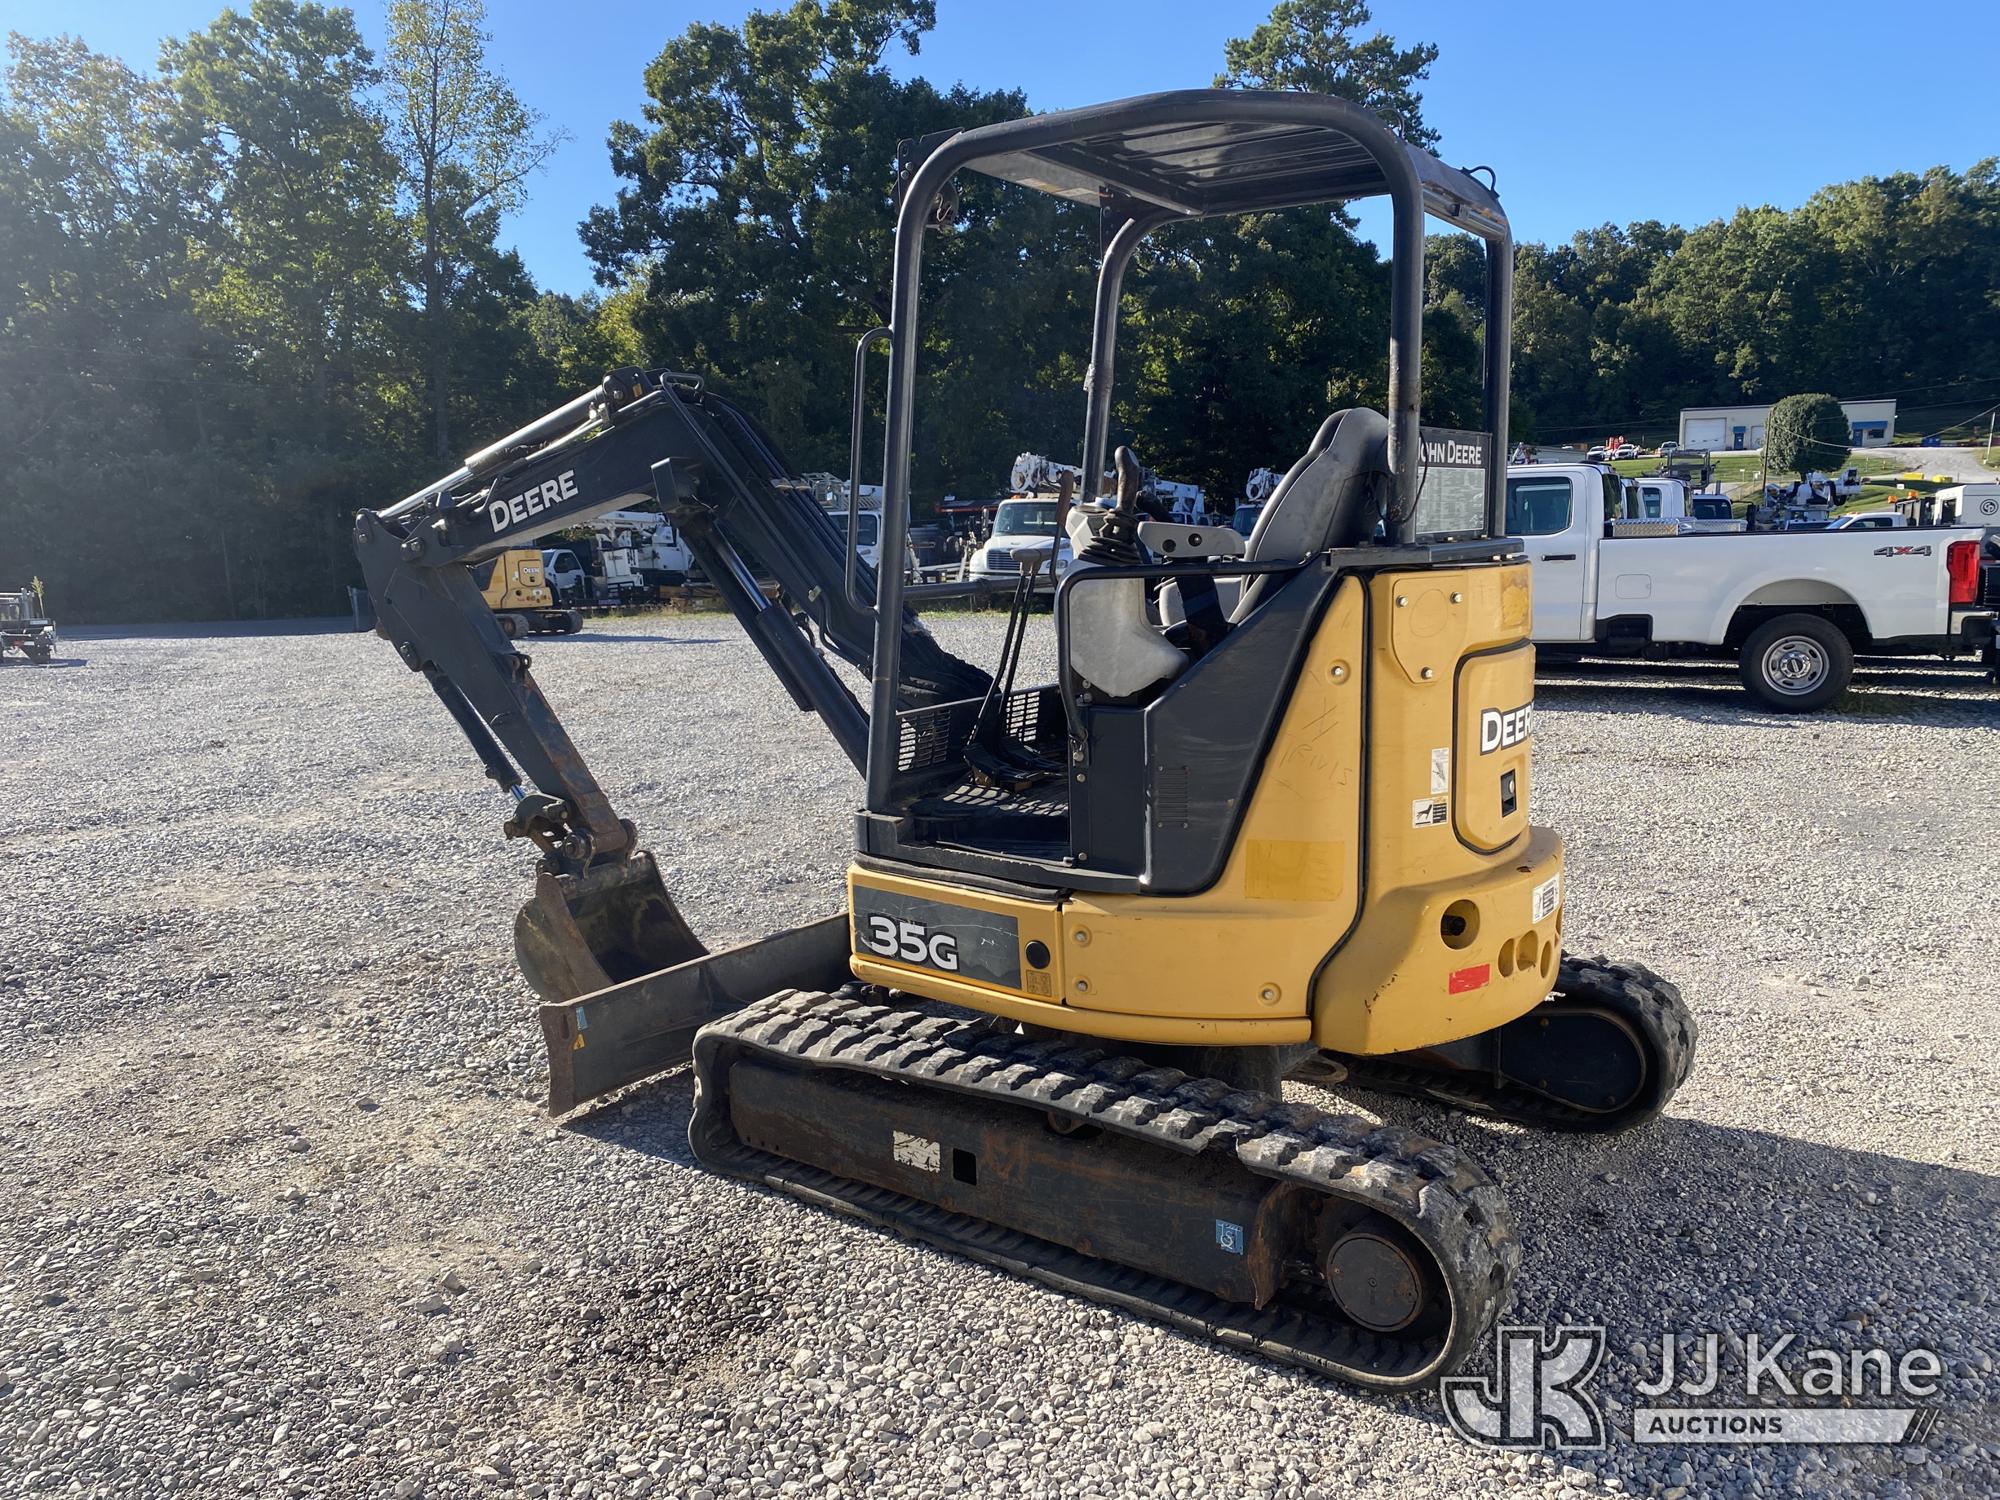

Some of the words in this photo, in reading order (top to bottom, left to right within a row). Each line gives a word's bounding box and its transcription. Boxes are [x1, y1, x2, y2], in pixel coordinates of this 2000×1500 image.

[1447, 440, 1482, 465] DEERE
[488, 469, 579, 533] DEERE
[1481, 701, 1534, 753] DEER
[869, 915, 959, 971] 35G
